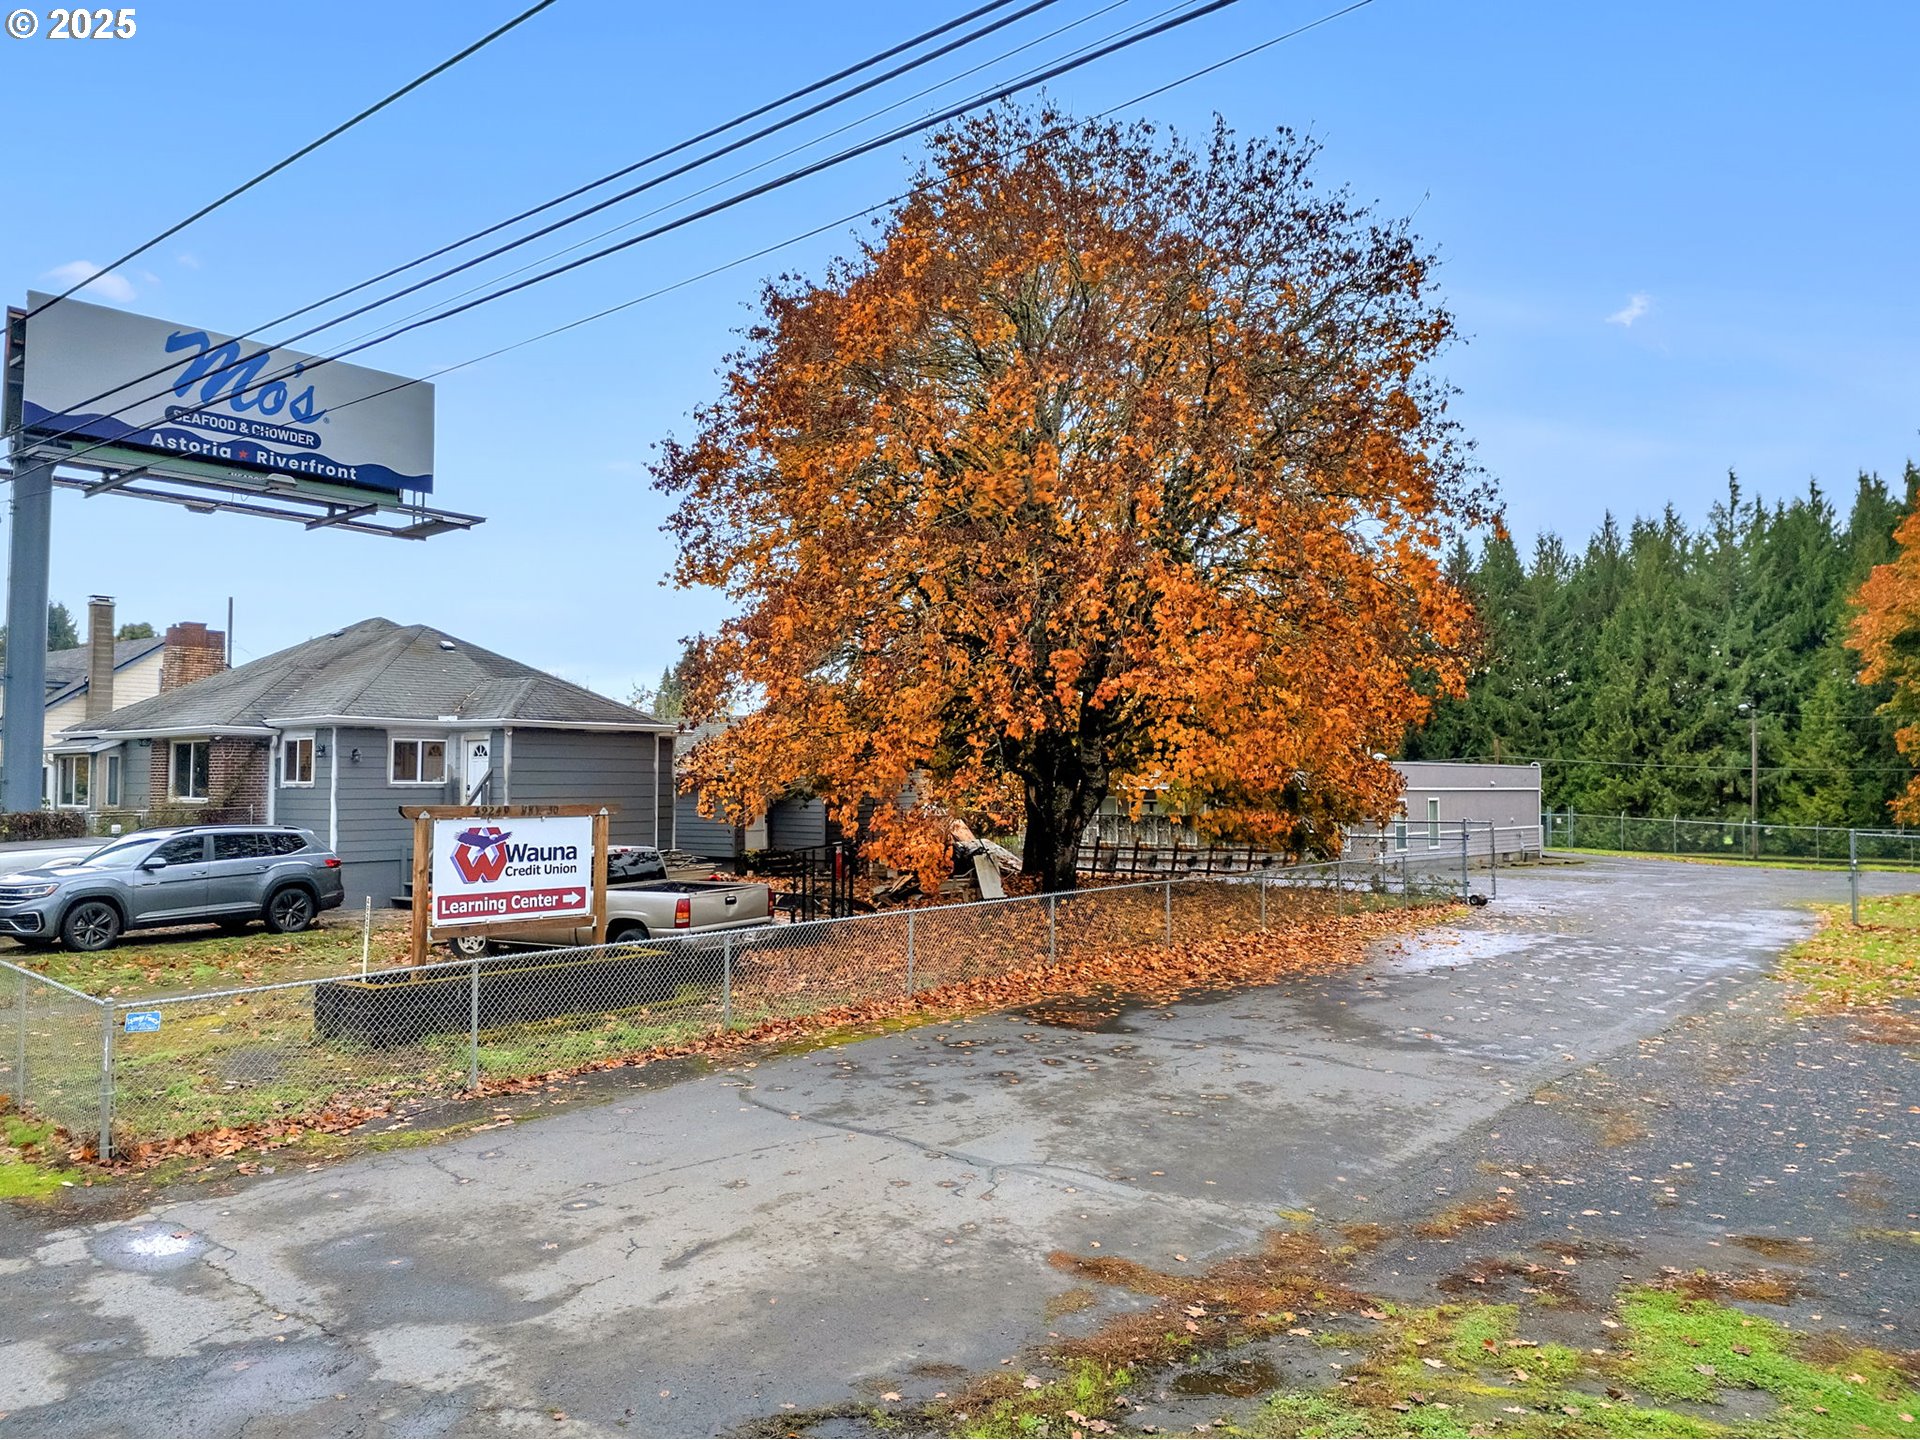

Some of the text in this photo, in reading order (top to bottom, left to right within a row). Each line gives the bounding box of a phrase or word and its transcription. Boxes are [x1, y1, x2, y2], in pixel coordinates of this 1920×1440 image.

[165, 331, 328, 424] Mo's
[173, 409, 315, 446] SEAFOOD & CHOWDER
[151, 433, 357, 480] Astoria Riverfront
[505, 843, 577, 863] Wauna
[505, 863, 577, 877] Credit Union
[441, 895, 559, 915] Learning Center
